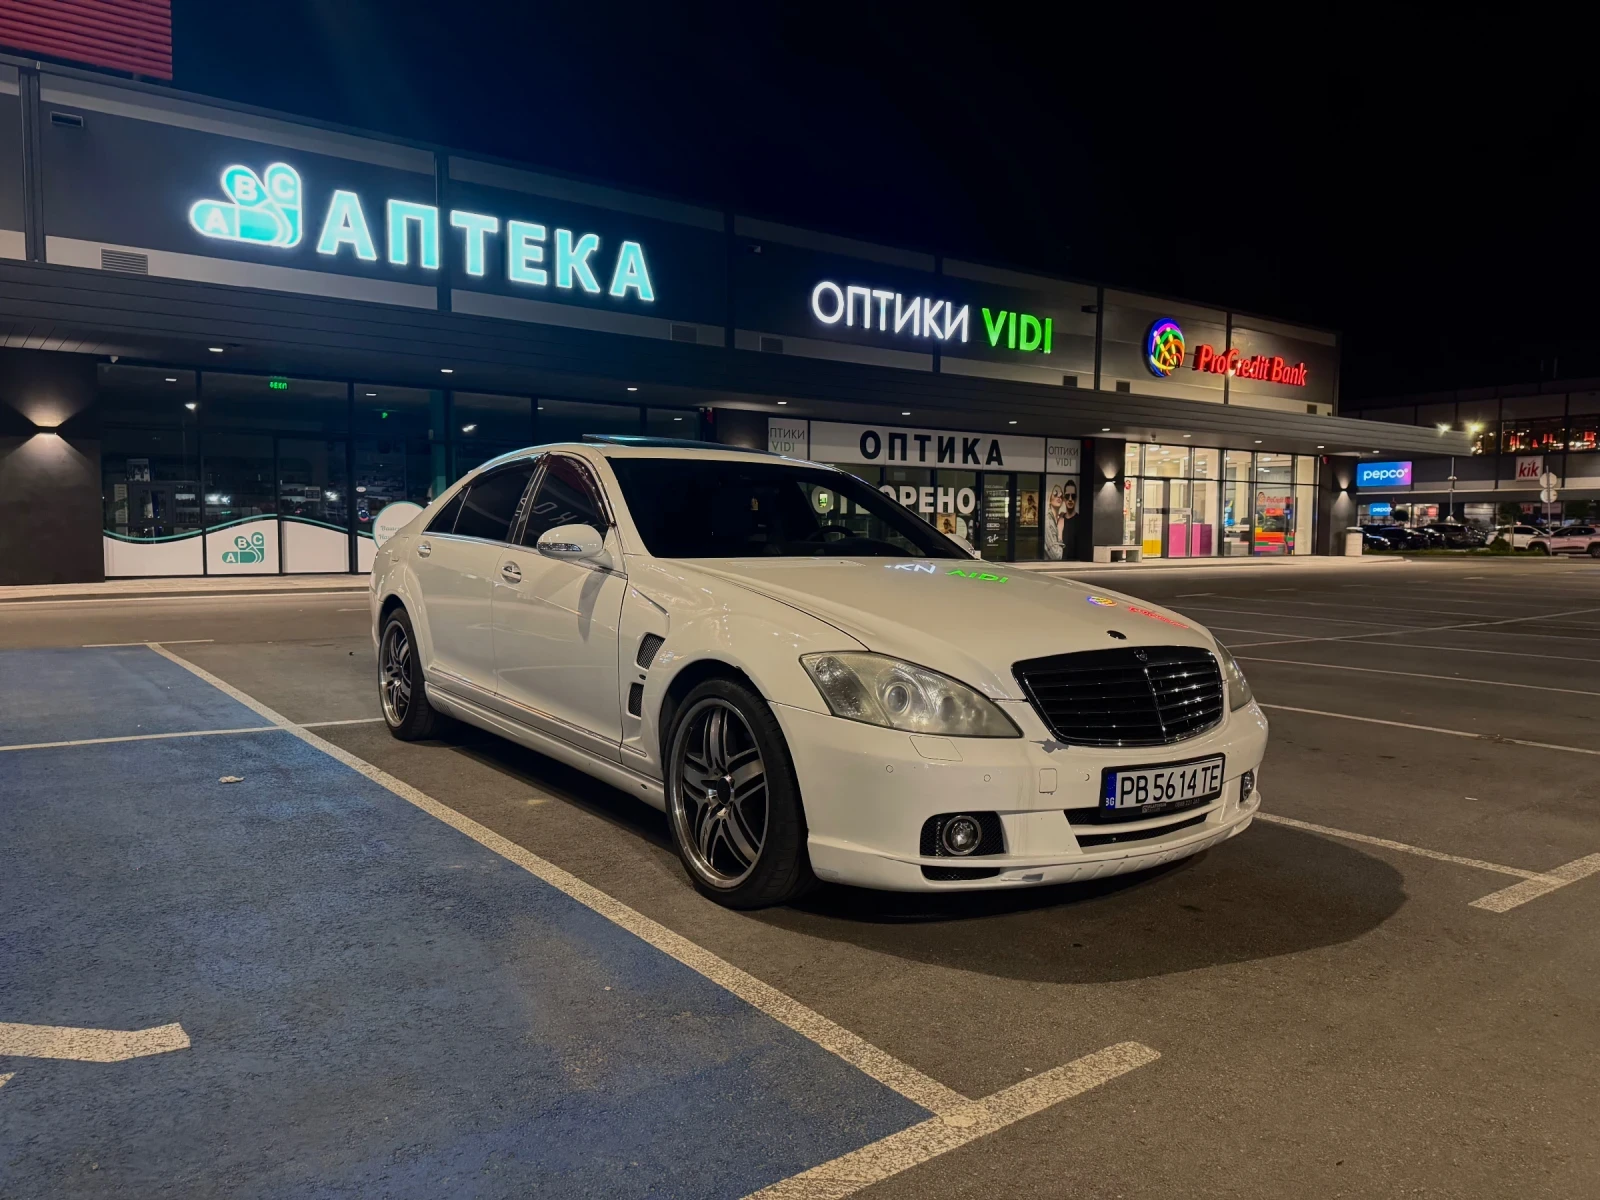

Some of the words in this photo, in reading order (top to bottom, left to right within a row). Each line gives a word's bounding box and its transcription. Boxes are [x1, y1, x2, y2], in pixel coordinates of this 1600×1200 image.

[316, 189, 655, 301] АПТЕКА
[811, 281, 970, 343] ОПТИКИ
[981, 307, 1053, 354] VIDI
[1196, 343, 1270, 381] ProCredit
[1270, 356, 1309, 387] Bank
[769, 427, 805, 440] ПТИКИ
[771, 440, 795, 453] VIDI
[859, 429, 1004, 467] ОПТИКА
[1048, 445, 1079, 457] ОПТИКИ
[1055, 457, 1072, 467] VIDI
[1518, 461, 1539, 478] kik
[1363, 468, 1405, 482] pepco
